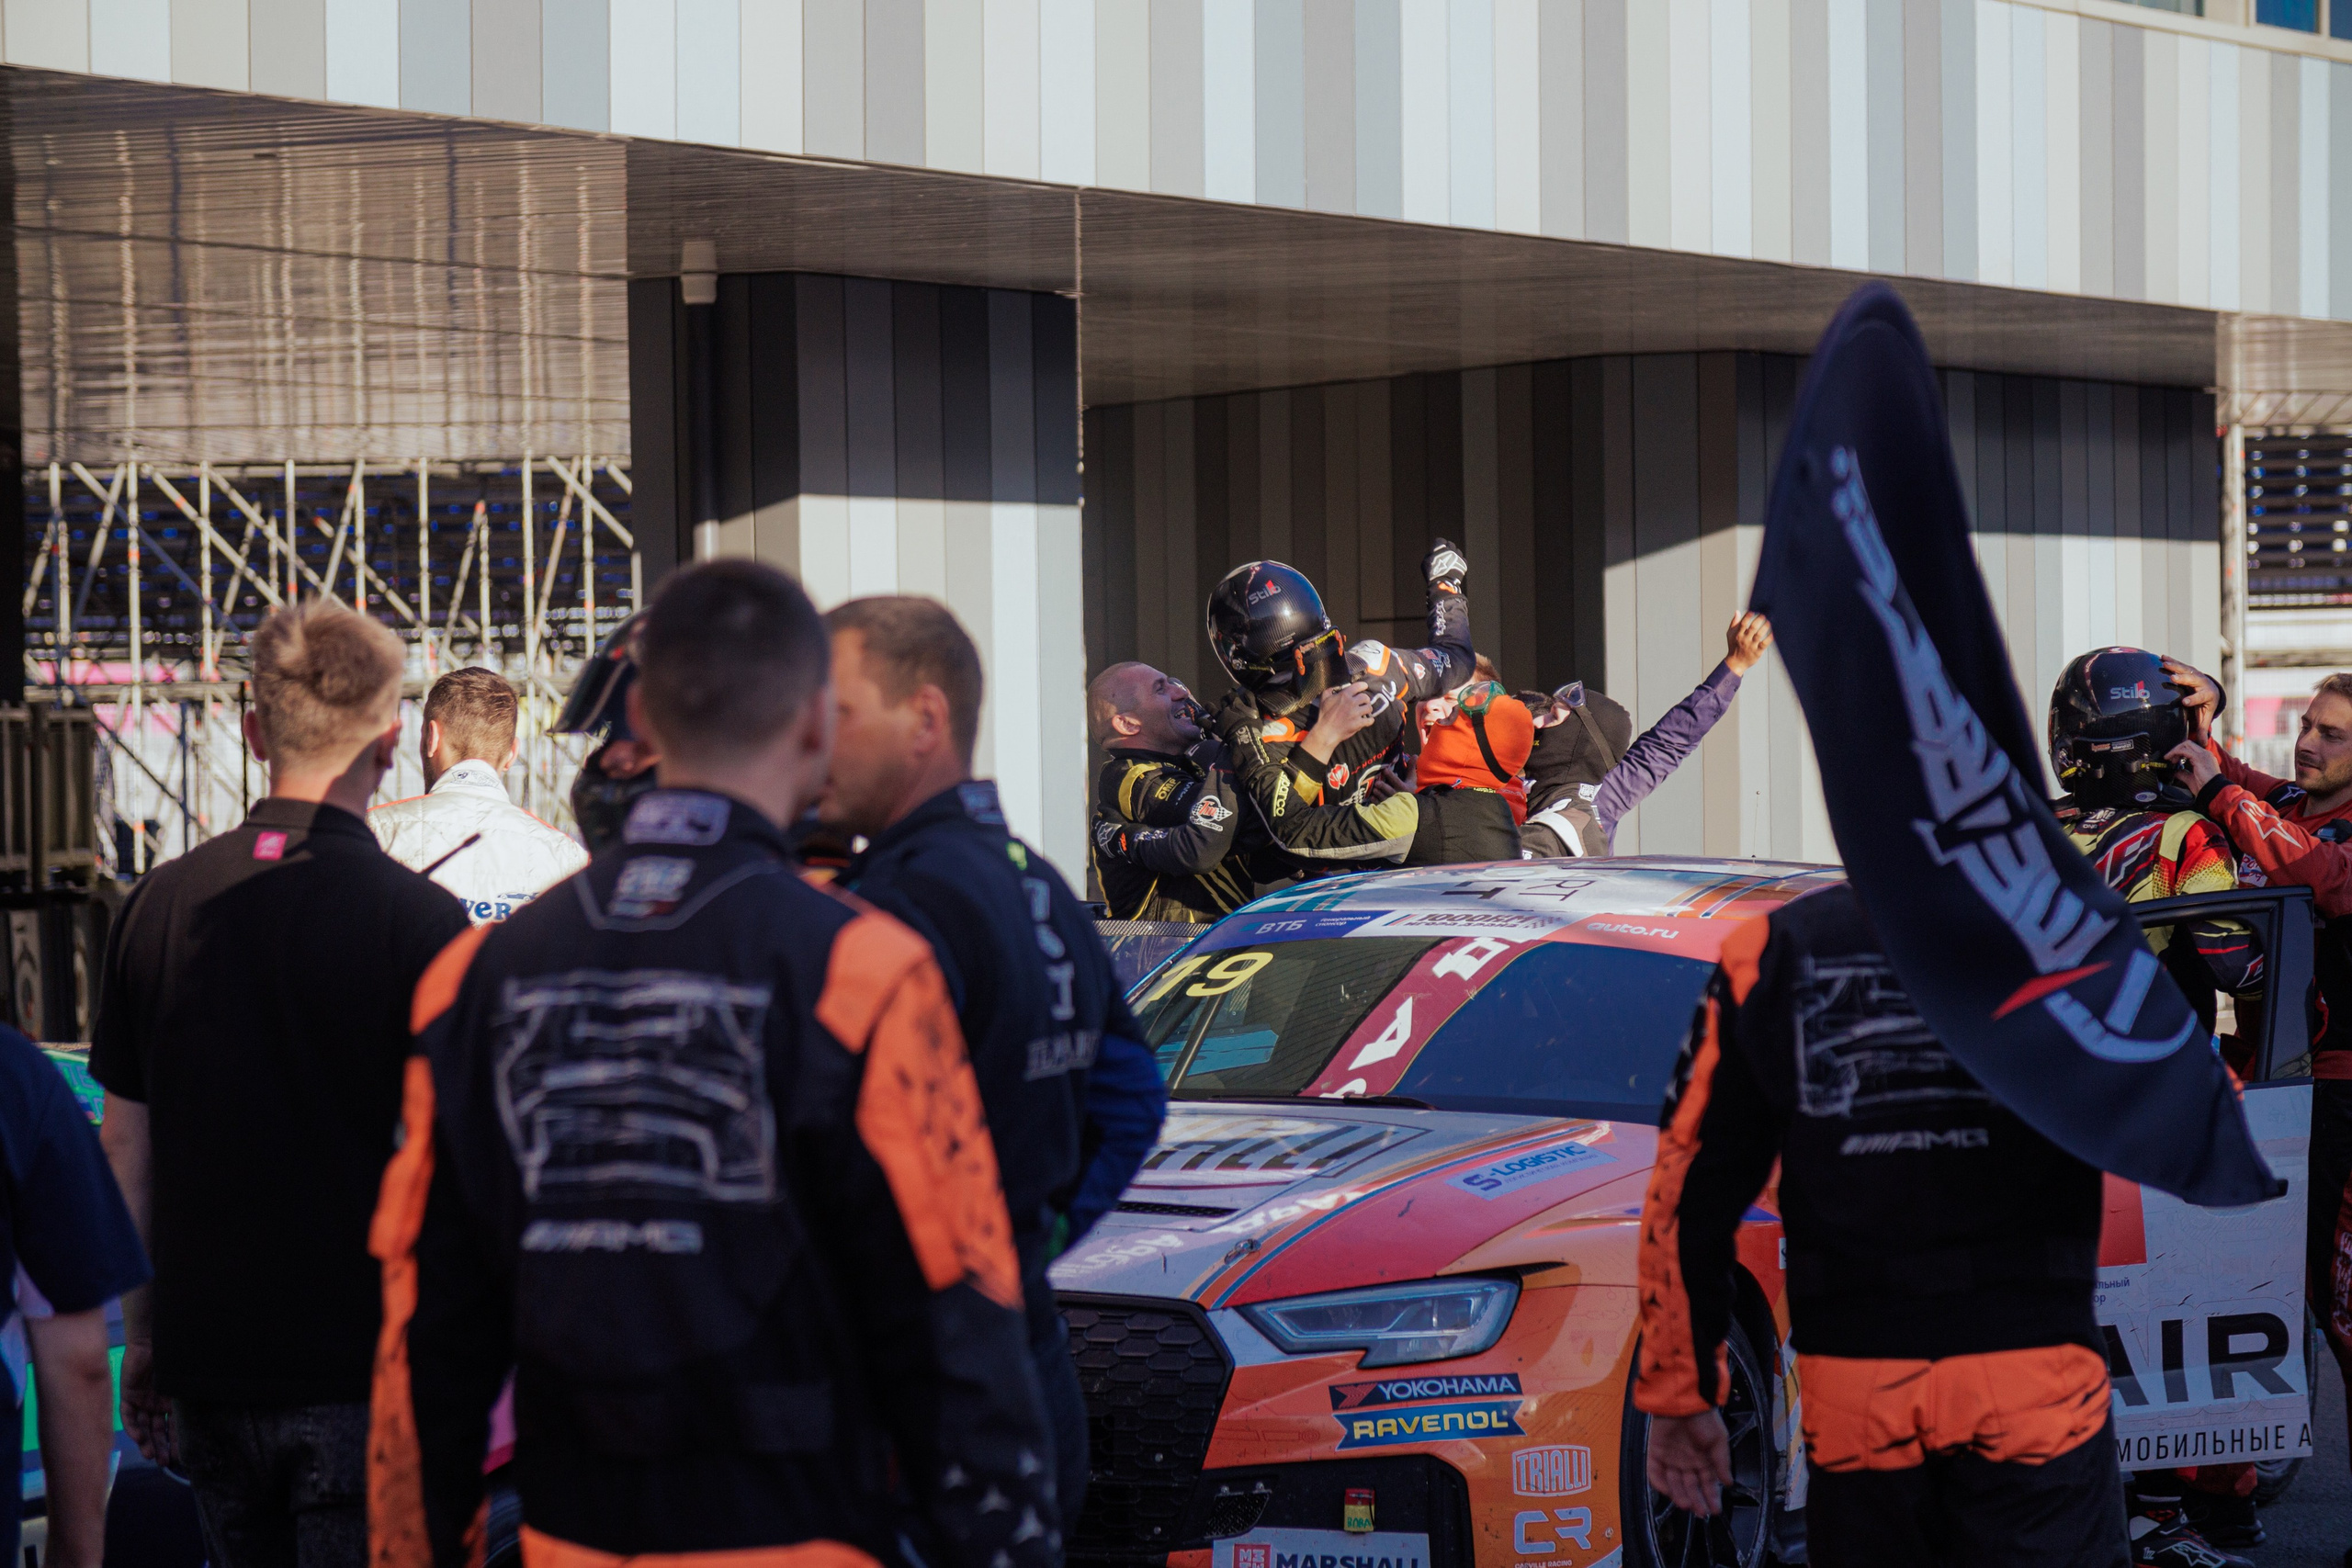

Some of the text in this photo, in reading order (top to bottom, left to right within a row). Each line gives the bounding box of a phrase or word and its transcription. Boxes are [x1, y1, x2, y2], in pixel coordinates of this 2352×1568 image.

[1249, 580, 1282, 605] Stilo
[2110, 680, 2150, 700] Stilo
[1158, 778, 1178, 800] OMP
[1255, 919, 1306, 935] ВТБ
[1587, 920, 1679, 940] auto.ru
[1148, 952, 1274, 1002] 19
[1463, 1145, 1587, 1192] S-LOGISTIC
[1378, 1376, 1517, 1401] YOKOHAMA
[1353, 1409, 1509, 1440] RAVENOL
[2116, 1425, 2286, 1462] МОБИЛЬНЫЕ
[1517, 1450, 1587, 1492] TRIALLI
[1514, 1506, 1592, 1554] CR
